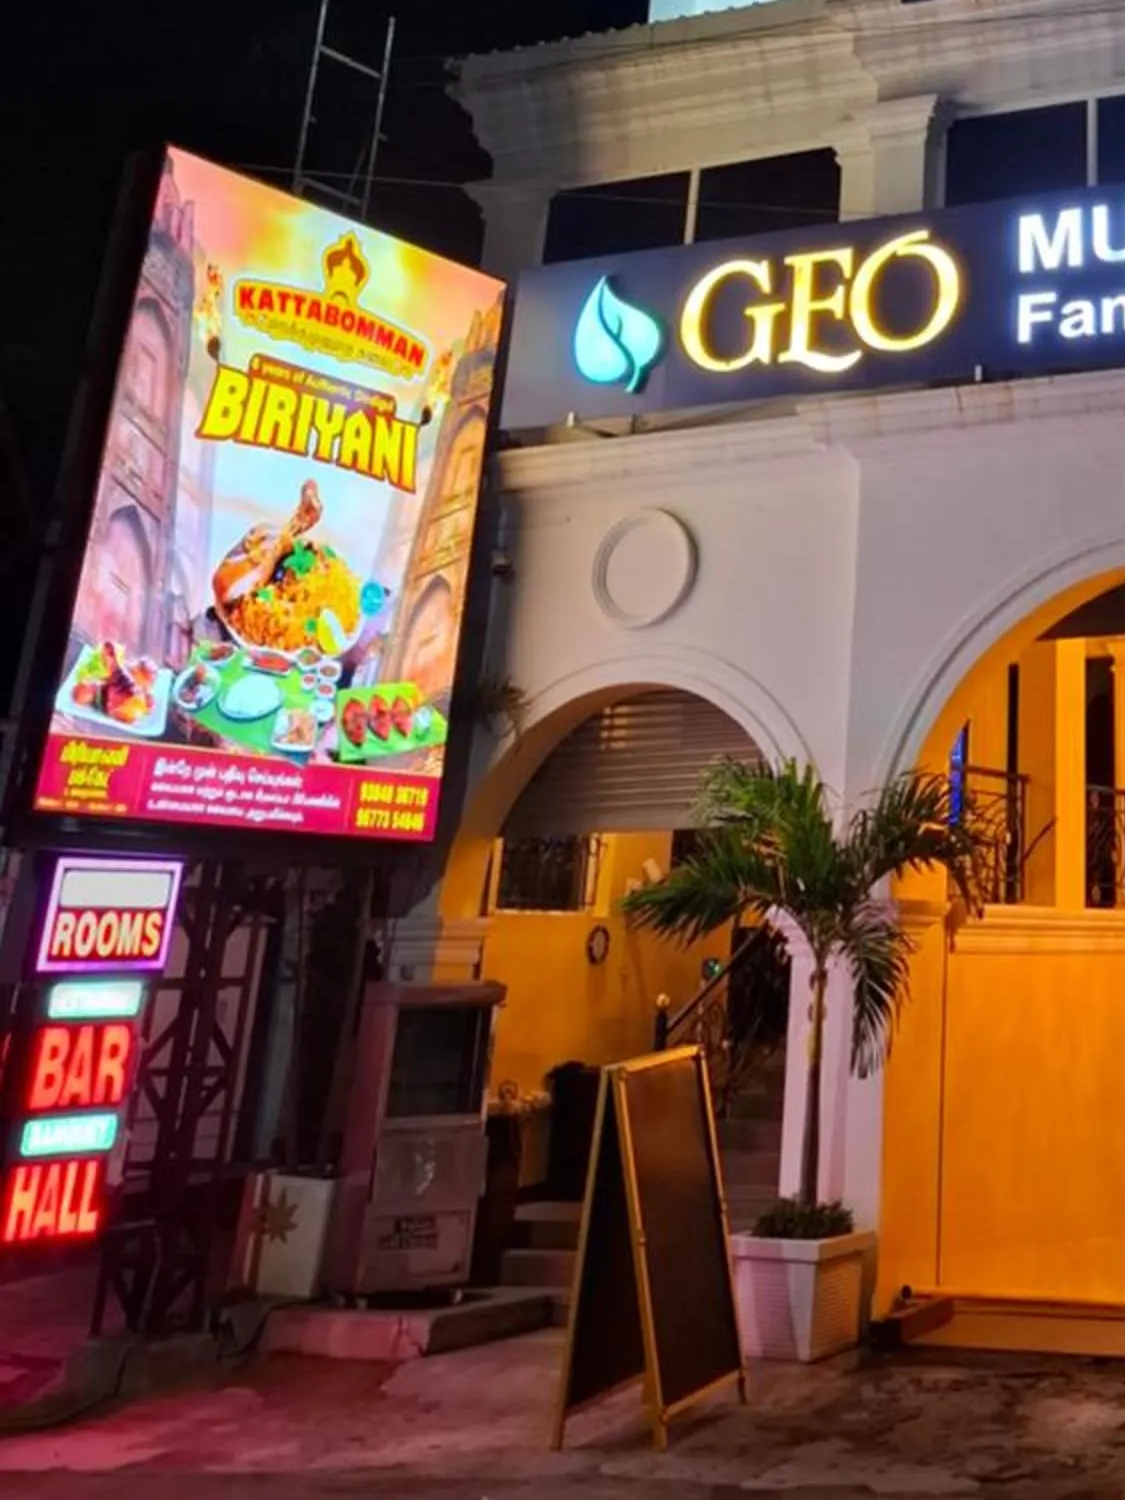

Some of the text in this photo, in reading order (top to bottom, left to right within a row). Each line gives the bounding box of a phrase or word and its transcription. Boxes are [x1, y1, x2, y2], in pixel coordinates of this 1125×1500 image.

[238, 286, 426, 368] KATTABOMMAN
[679, 229, 961, 373] GEO
[196, 364, 420, 494] BIRIYANI
[51, 909, 164, 958] ROOMS
[30, 1026, 131, 1109] BAR
[4, 1158, 100, 1243] HALL
